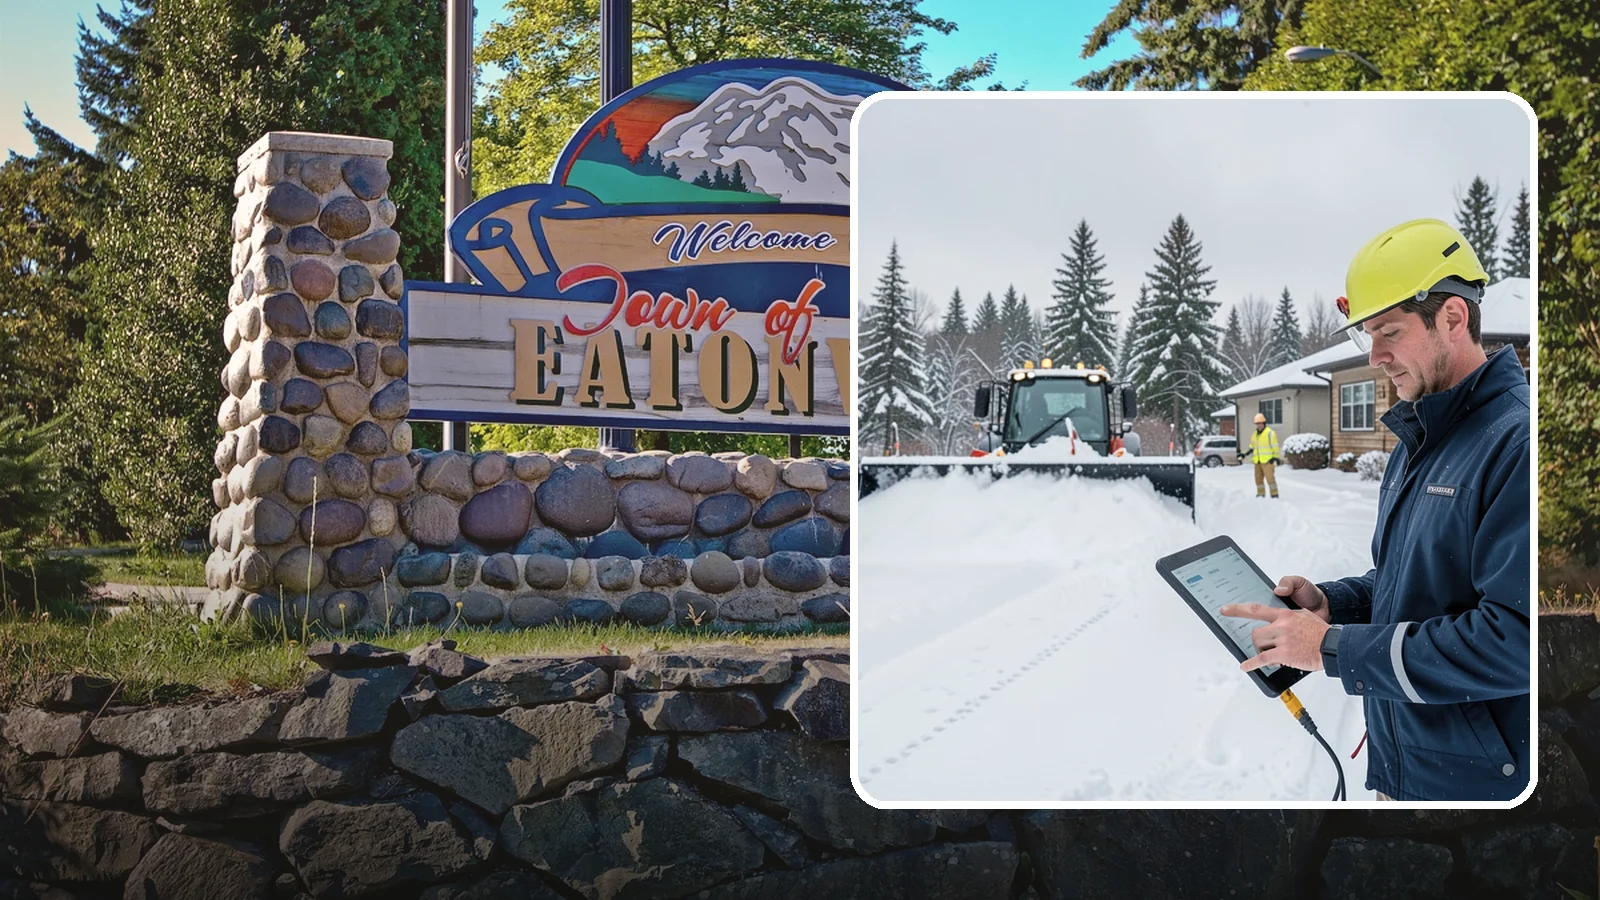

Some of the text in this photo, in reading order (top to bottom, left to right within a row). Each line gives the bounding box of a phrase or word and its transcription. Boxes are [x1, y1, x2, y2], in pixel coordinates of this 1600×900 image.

[653, 221, 837, 263] Welcome
[556, 263, 826, 365] Town of
